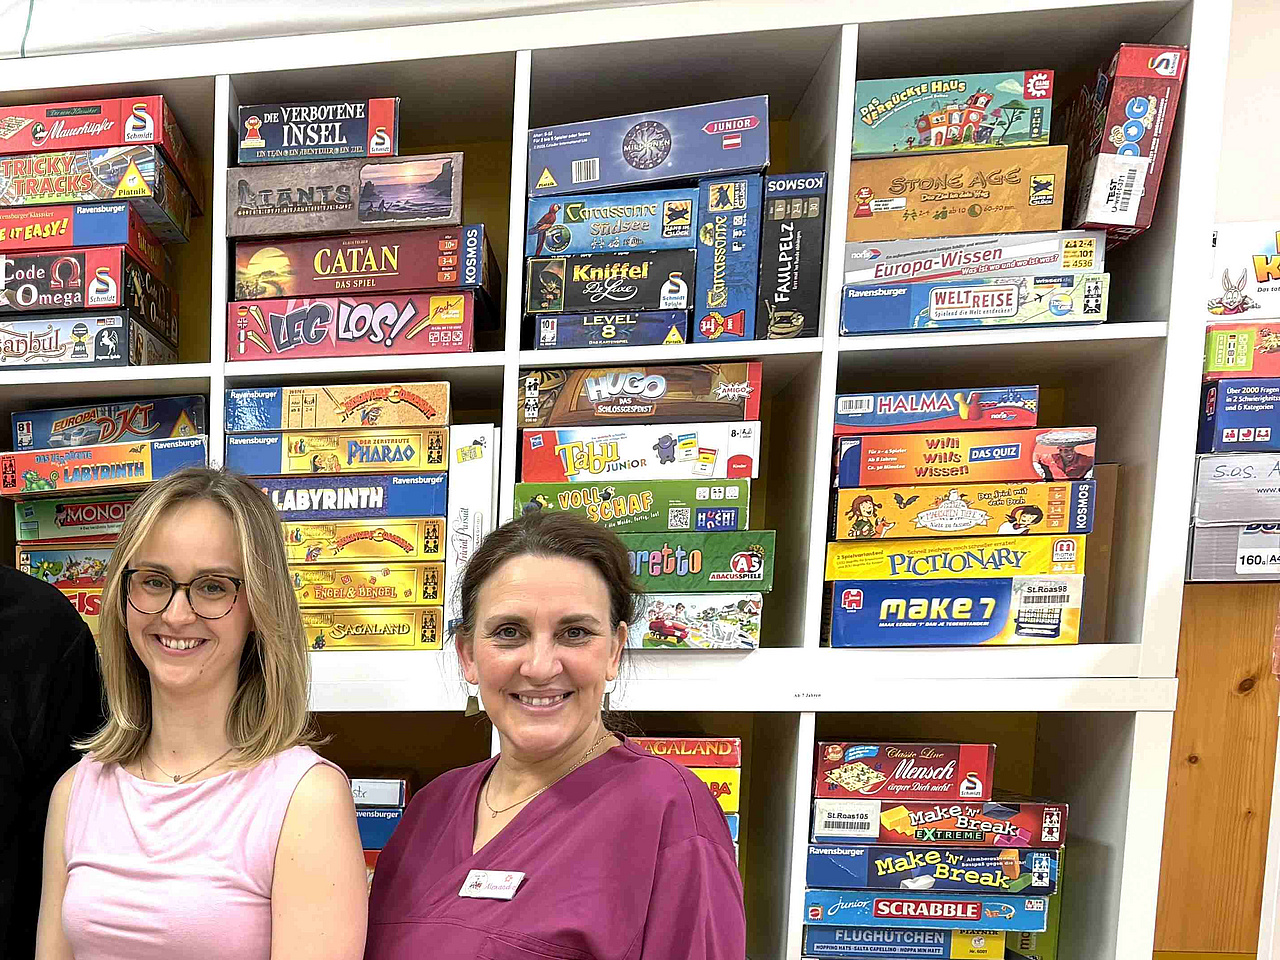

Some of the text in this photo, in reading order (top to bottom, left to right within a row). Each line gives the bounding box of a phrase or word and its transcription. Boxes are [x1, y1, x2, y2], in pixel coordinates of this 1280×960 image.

[860, 83, 929, 126] VERRÜCKTE
[931, 78, 966, 95] HAUS
[860, 97, 880, 116] DAS
[263, 103, 365, 124] DIE VERBOTENE
[282, 123, 347, 147] INSEL
[713, 118, 751, 132] JUNIOR
[126, 132, 154, 140] Schmidt
[2, 154, 74, 177] TRICKY
[13, 173, 93, 198] TRACKS
[768, 178, 823, 191] KOSMOS
[888, 167, 1022, 195] STONE AGE
[1106, 179, 1118, 204] TEST
[118, 188, 146, 196] Piatnik
[76, 204, 126, 214] Ravensburger
[564, 202, 658, 223] Carcassonne
[9, 226, 24, 240] IT
[24, 218, 69, 240] EASY!
[313, 245, 399, 275] CATAN
[465, 229, 478, 284] KOSMOS
[707, 216, 728, 308] Carcassonne
[774, 222, 794, 303] FAULPELZ
[874, 248, 1003, 279] Europa-Wissen
[962, 266, 977, 275] Was
[979, 265, 989, 273] ist
[1002, 261, 1016, 269] und
[1017, 260, 1028, 268] wo
[1029, 257, 1039, 266] ist
[1040, 255, 1059, 265] was?
[1072, 259, 1092, 267] 4536
[4, 259, 46, 283] Code
[572, 261, 650, 282] Kniffel
[335, 279, 376, 289] DAS SPIEL
[848, 287, 907, 298] Ravensburger
[16, 284, 82, 306] Omega
[89, 295, 116, 304] Schmidt
[935, 291, 1013, 308] WELT REISE
[269, 299, 419, 352] LEG LOS!
[583, 314, 637, 325] LEVEL
[601, 324, 616, 339] 8
[231, 390, 277, 400] Ravensburger
[585, 372, 667, 401] HUGO
[721, 386, 747, 395] AMIGO
[597, 404, 653, 414] SCHLOSSGESPENST
[619, 397, 632, 405] DAS
[877, 392, 954, 414] HALMA
[52, 408, 97, 433] EUROPA
[96, 403, 160, 443] DKT
[154, 439, 203, 449] Ravensburger
[229, 436, 278, 445] Ravensburger
[35, 454, 49, 464] DAS
[346, 440, 416, 465] PHARAO
[555, 441, 620, 477] Tabu
[971, 446, 1017, 460] DAS QUIZ
[64, 461, 145, 483] LABYRINTH
[606, 458, 647, 473] JUNIOR
[1213, 465, 1256, 478] S.O.S.
[392, 476, 444, 485] Ravensburger
[272, 487, 384, 512] LABYRINTH
[559, 488, 600, 510] VOLL
[587, 491, 654, 523] SCHAF
[1076, 484, 1089, 529] KOSMOS
[887, 547, 1028, 576] PICTIONARY
[1240, 555, 1262, 565] 160
[315, 585, 397, 599] ENGEL & BENGEL
[1027, 585, 1068, 594] St.Roas98
[879, 597, 996, 620] make 7
[330, 624, 410, 639] SAGALAND
[886, 747, 917, 759] Classic
[920, 748, 944, 759] Line
[892, 759, 954, 780] Mensch
[827, 812, 869, 820] St.Roas105
[909, 805, 961, 826] Make
[956, 816, 1017, 836] Break
[914, 828, 985, 841] EXTREME
[809, 847, 864, 856] Ravensburger
[876, 851, 940, 876] Make
[934, 864, 1010, 888] Break
[828, 897, 978, 918] junior SCRABBLE
[835, 928, 944, 944] FLUGHÜTCHEN
